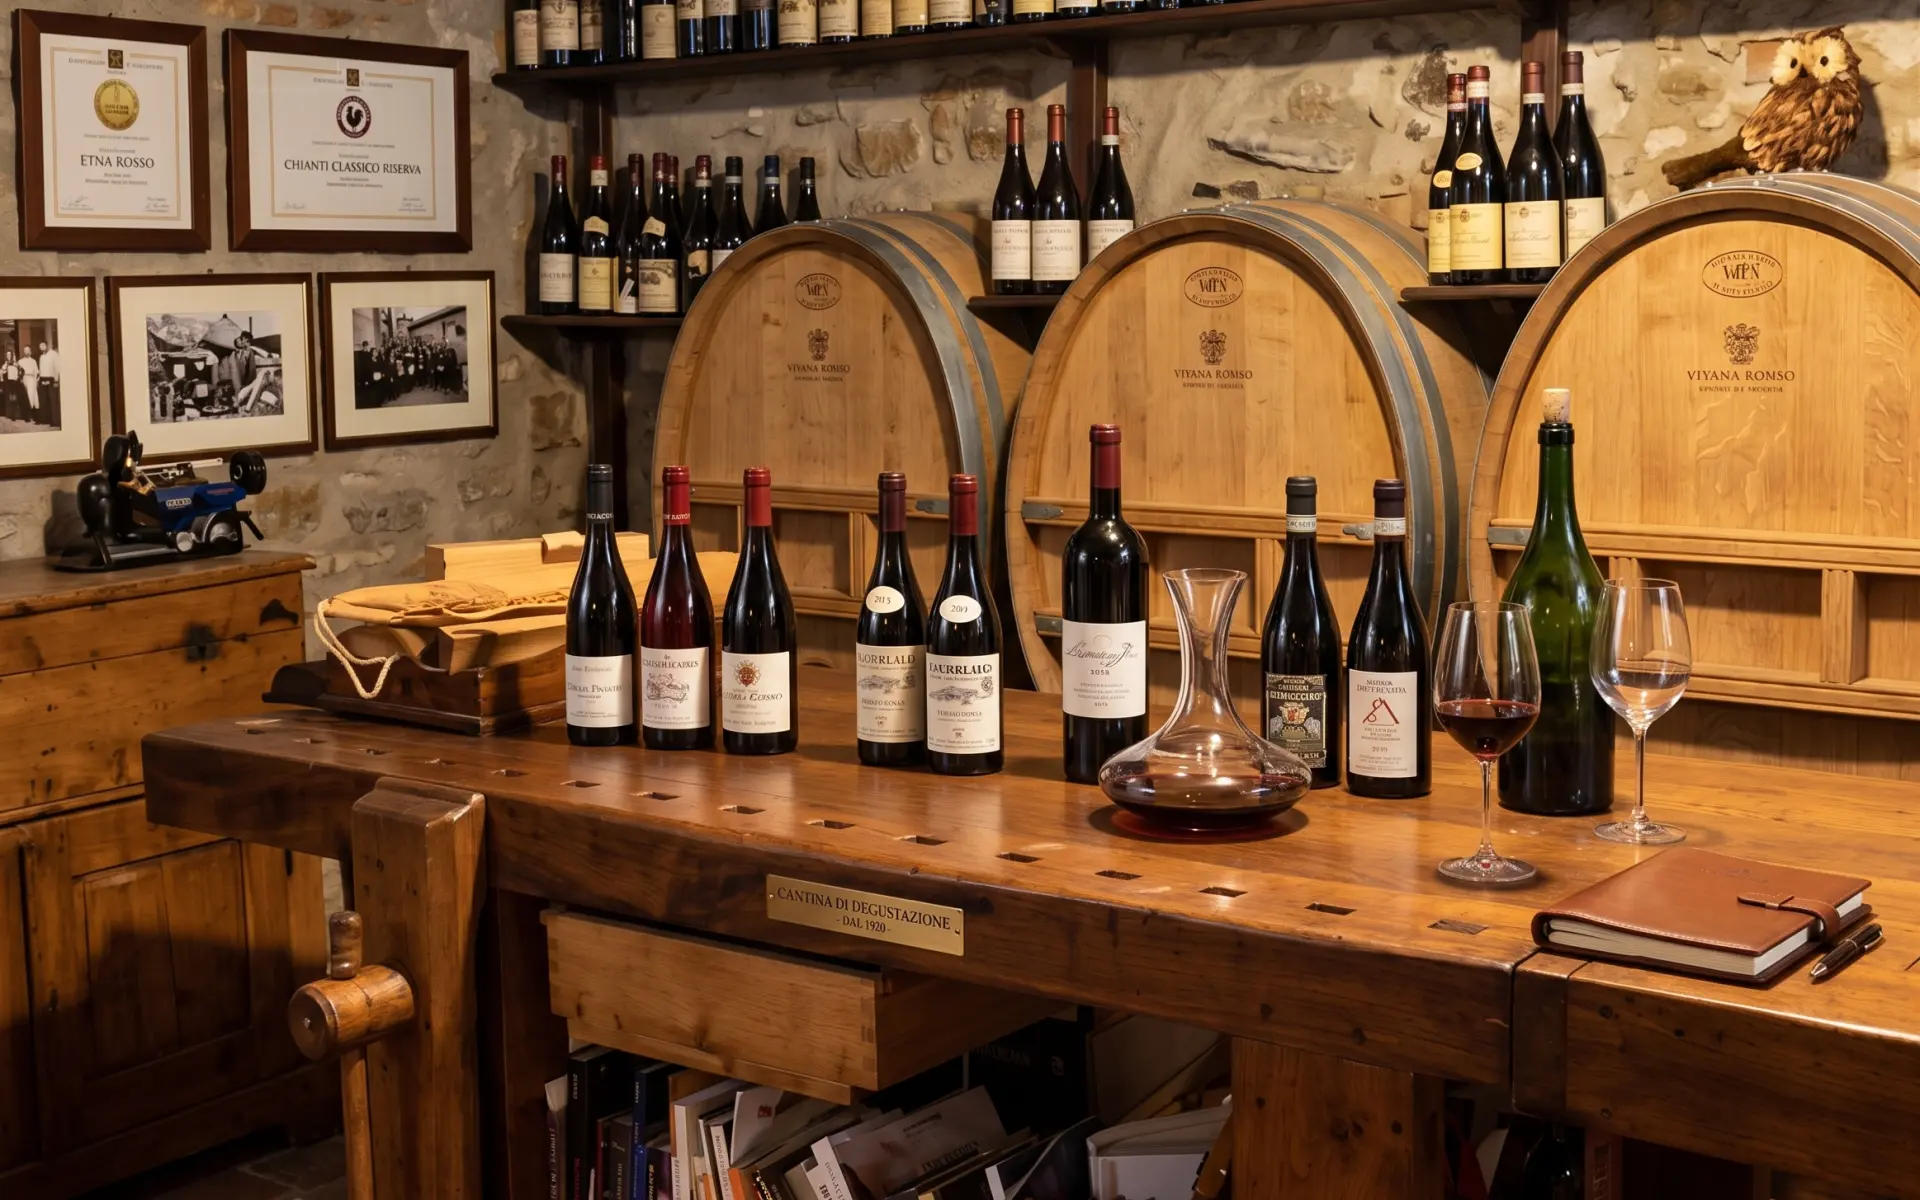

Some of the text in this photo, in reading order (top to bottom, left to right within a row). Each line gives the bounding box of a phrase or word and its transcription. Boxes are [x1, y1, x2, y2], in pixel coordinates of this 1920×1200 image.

[80, 154, 155, 169] ETNA ROSSO
[284, 159, 422, 175] CHIANTI CLASSICO RISERVA
[1174, 369, 1213, 379] VIYANA
[1687, 370, 1740, 381] VIYANA
[777, 886, 951, 931] CANTINA DI DEGUSTAZIONE
[842, 915, 863, 930] DAL
[865, 919, 886, 933] 1920
